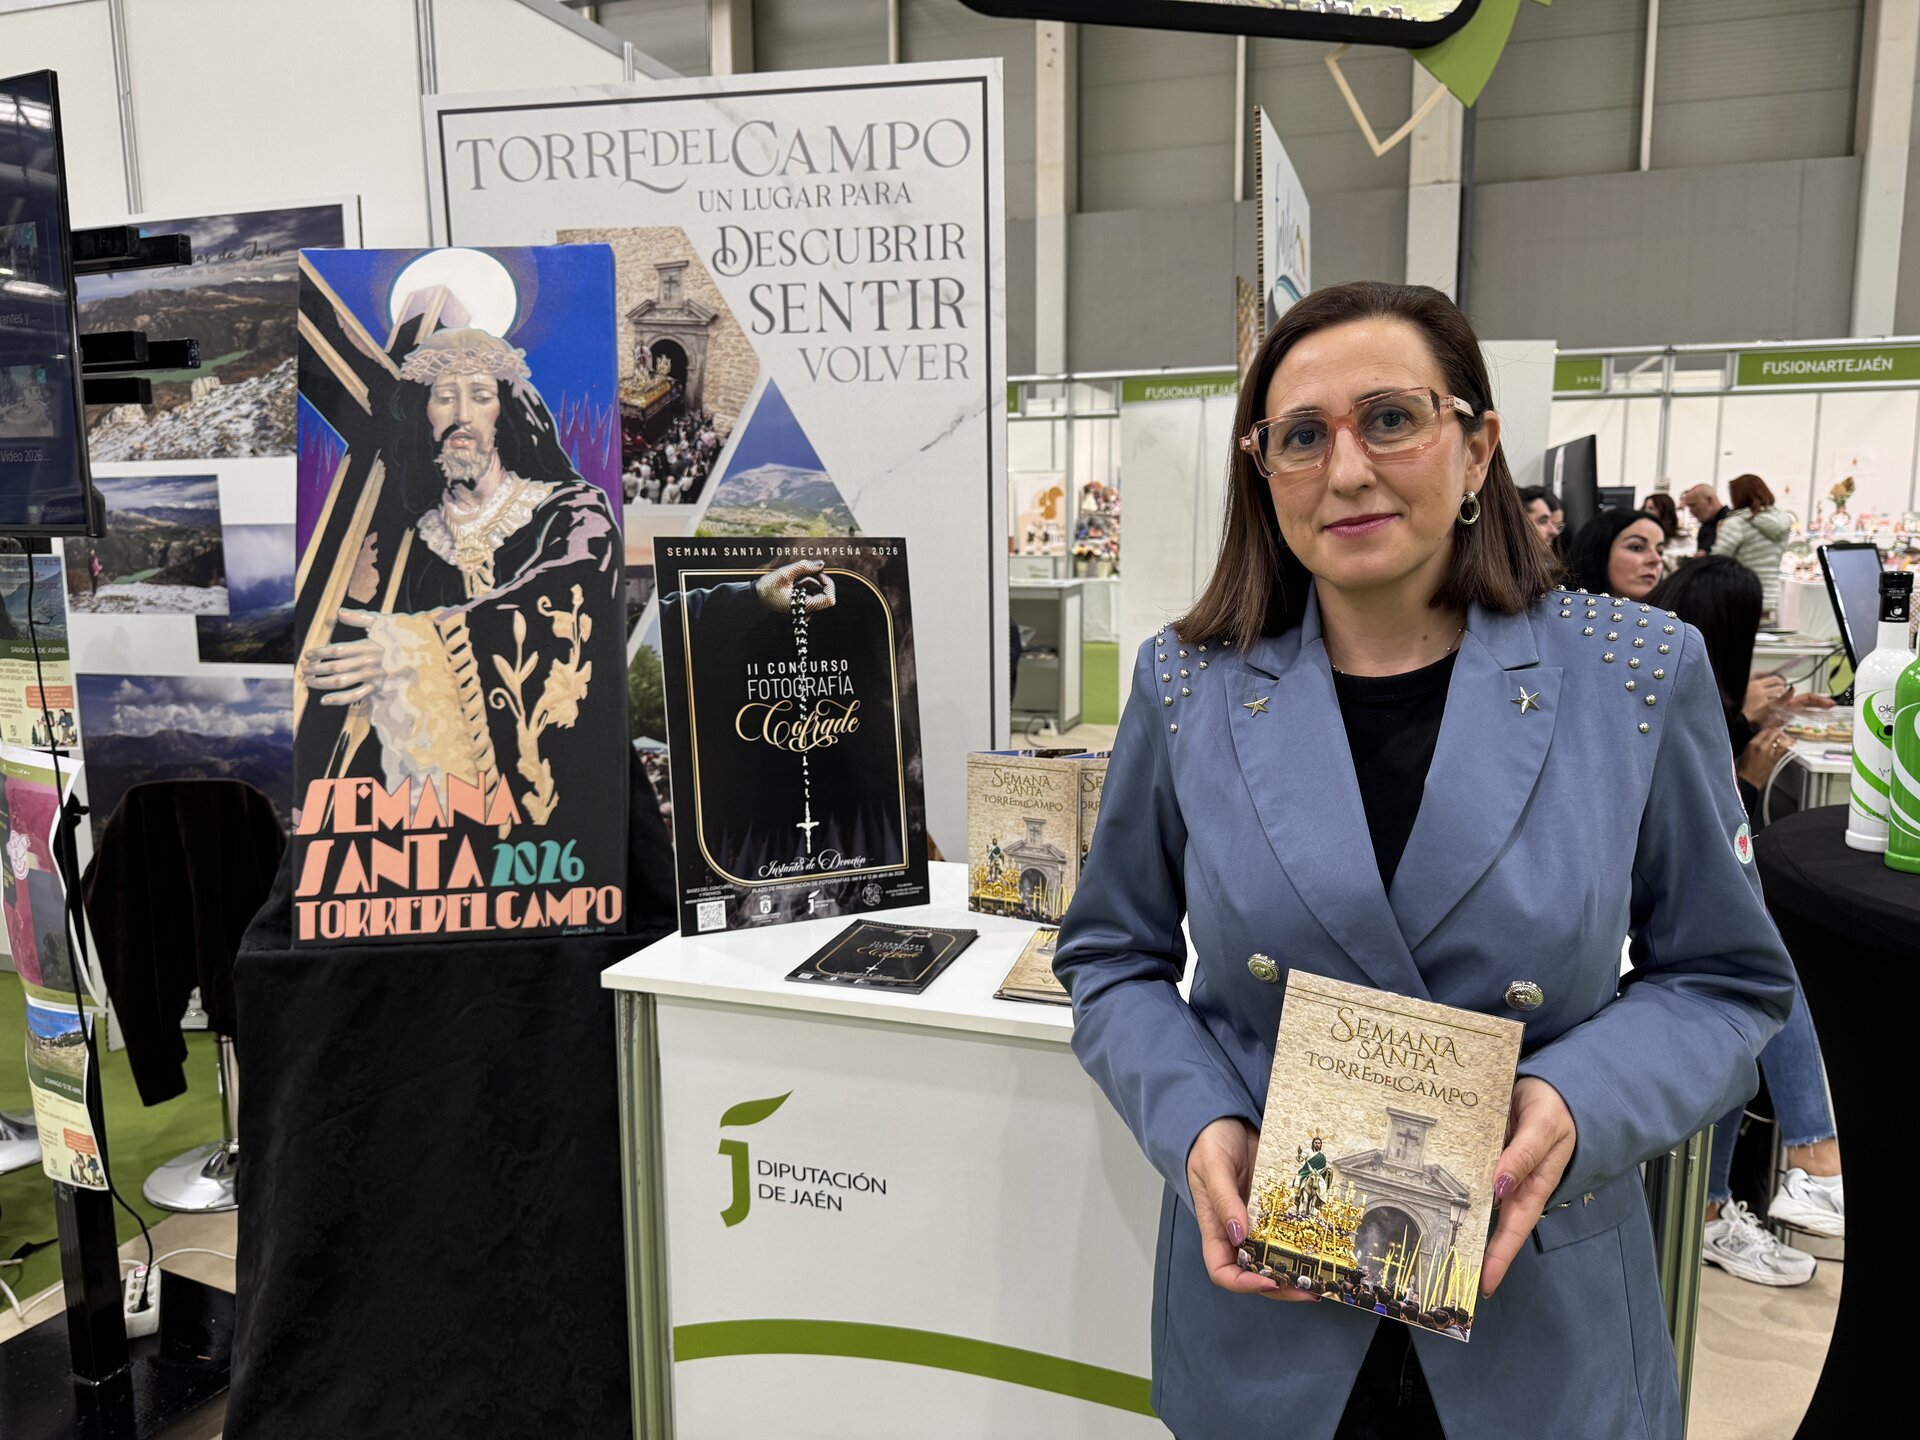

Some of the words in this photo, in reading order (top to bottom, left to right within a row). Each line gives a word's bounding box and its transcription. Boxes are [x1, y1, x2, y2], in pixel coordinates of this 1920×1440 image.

[698, 189, 733, 213] UN
[742, 184, 832, 211] LUGAR
[841, 181, 912, 207] PARA
[712, 222, 967, 277] DESCUBRIR
[749, 277, 968, 334] SENTIR
[797, 343, 970, 383] VOLVER
[1762, 357, 1894, 376] FUSIONARTEJAÉN
[1145, 382, 1239, 400] FUSIONARTEJAÉ
[667, 547, 717, 557] SEMANA
[723, 547, 763, 556] SANTA
[769, 545, 861, 556] TORRECAMPEÑA
[871, 546, 899, 556] 2026
[747, 663, 758, 675] II
[767, 659, 848, 675] CONCURSO
[747, 670, 854, 701] FOTOGRAFÍA
[735, 699, 860, 753] Cofrade
[991, 767, 1055, 791] SEMANA
[1006, 783, 1043, 797] SANTA
[294, 771, 522, 836] SEMANA
[294, 833, 485, 898] SANTA
[490, 838, 585, 888] 2026
[1330, 1006, 1466, 1067] SEMANA
[1357, 1040, 1439, 1075] SANTA
[757, 1158, 887, 1196] DIPUTACIÓN
[758, 1183, 787, 1203] DE
[790, 1189, 843, 1212] JAÉN
